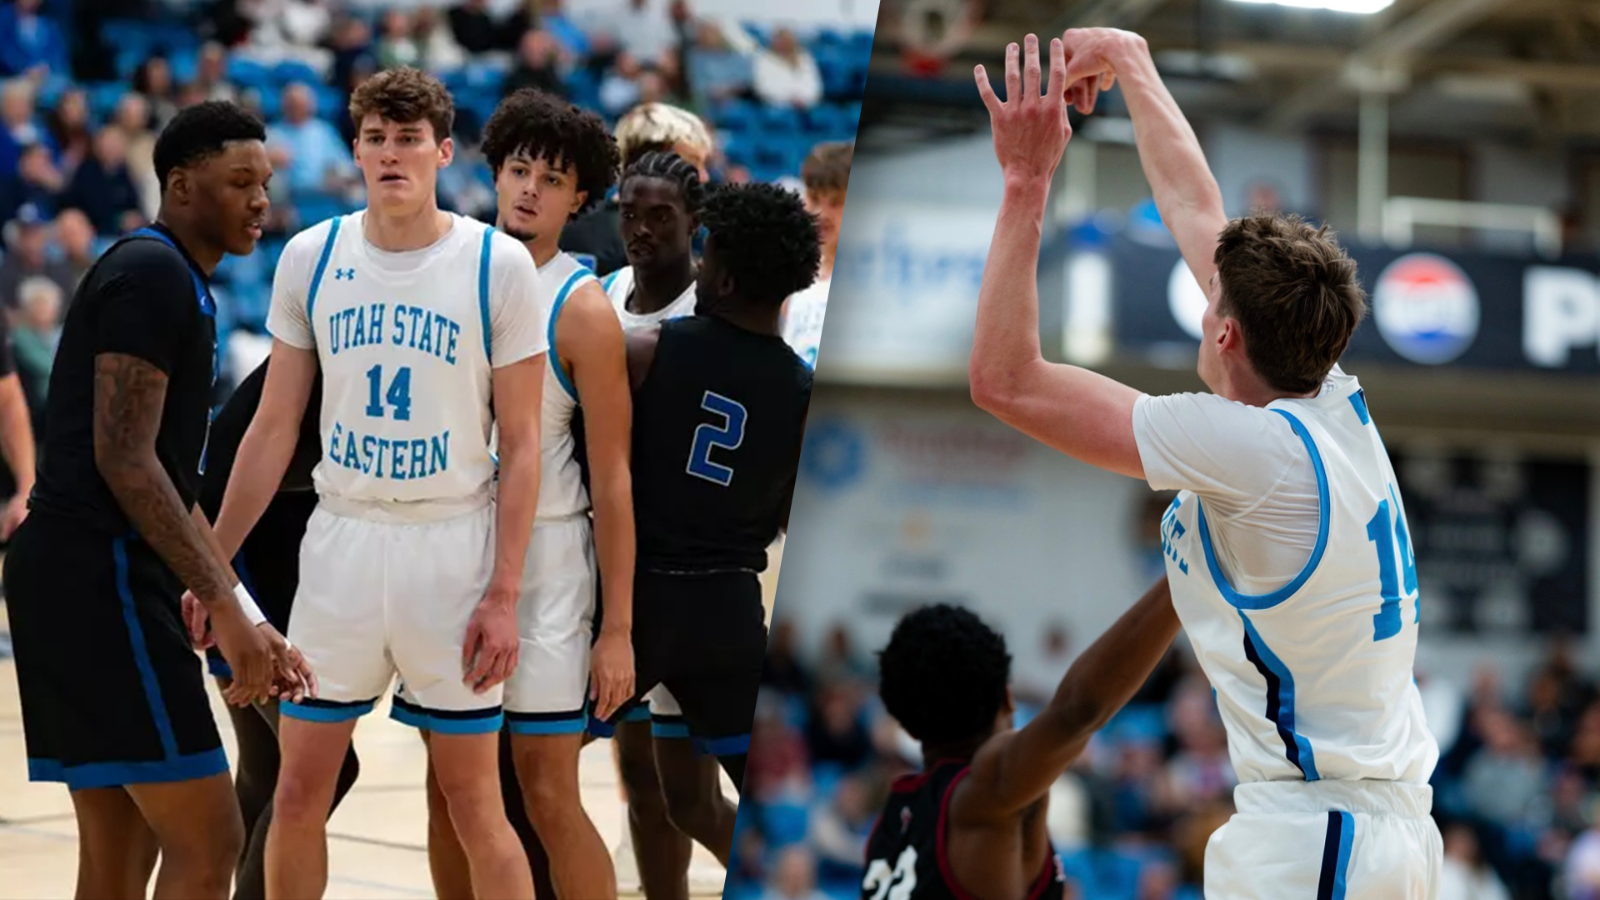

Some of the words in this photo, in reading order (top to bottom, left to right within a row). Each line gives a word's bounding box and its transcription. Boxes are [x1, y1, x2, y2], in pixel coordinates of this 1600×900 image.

[329, 303, 385, 355] UTAH
[392, 304, 460, 365] STATE
[366, 364, 411, 421] 14
[329, 421, 449, 480] EASTERN
[686, 390, 747, 486] 2
